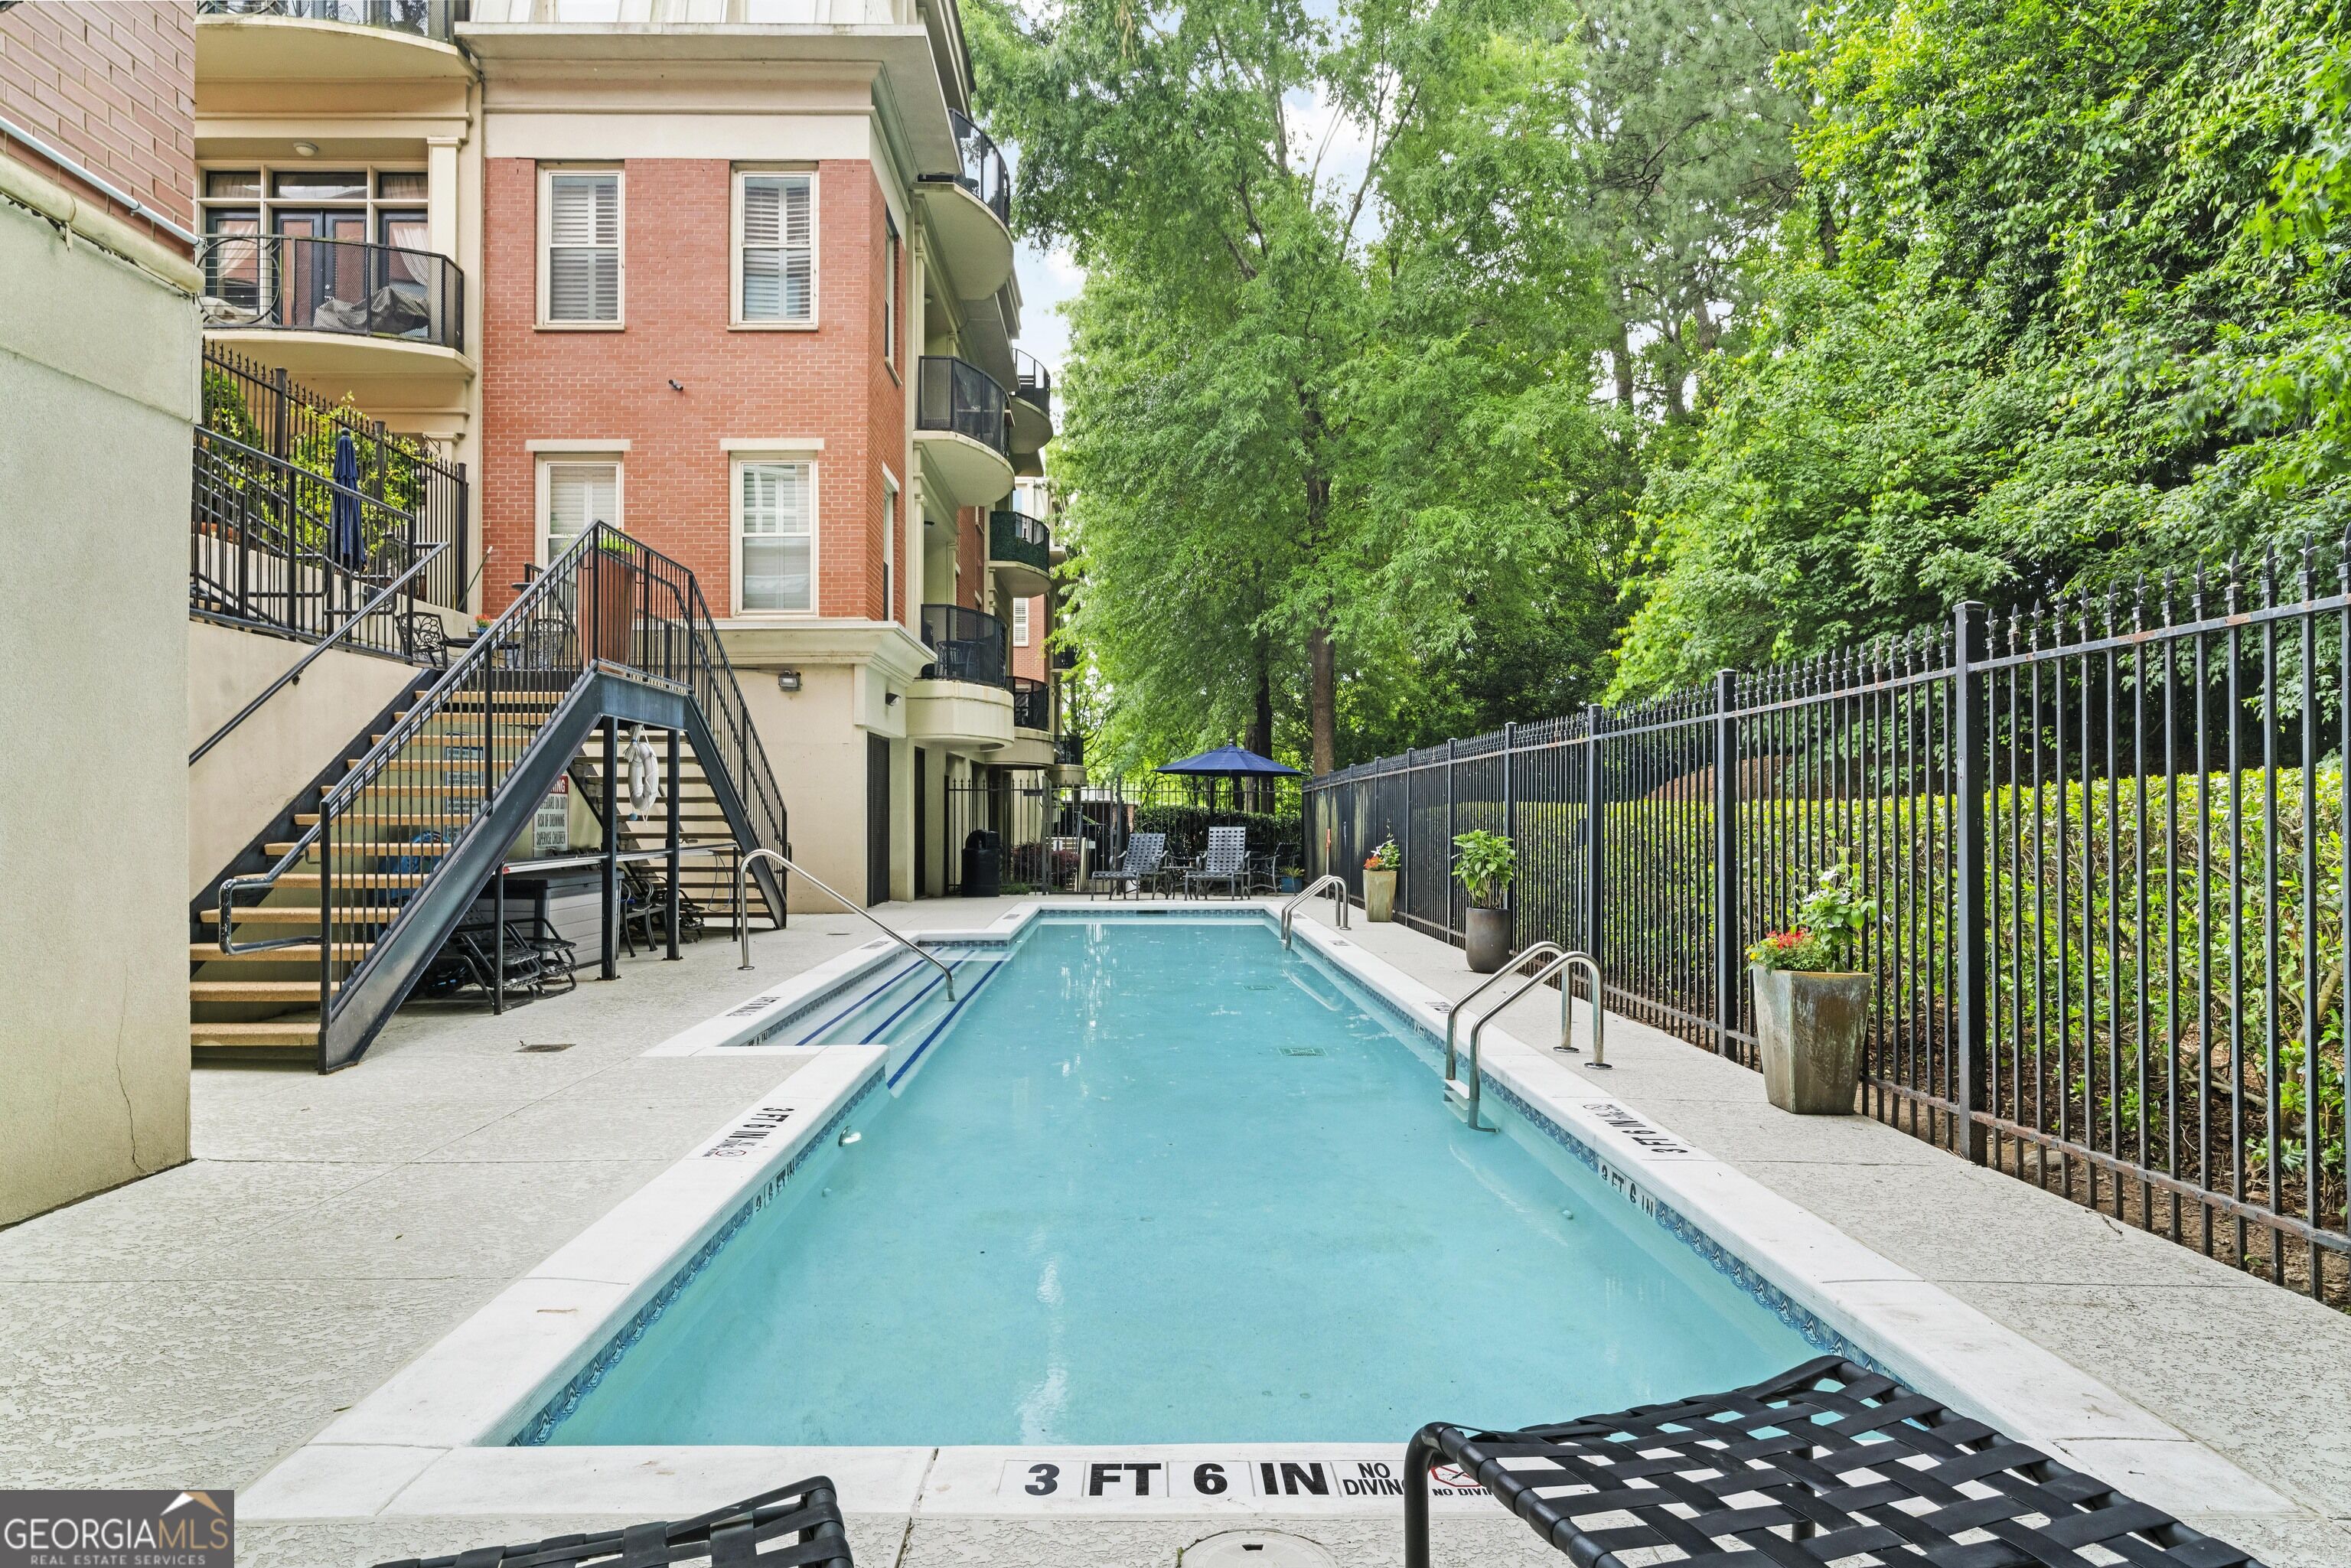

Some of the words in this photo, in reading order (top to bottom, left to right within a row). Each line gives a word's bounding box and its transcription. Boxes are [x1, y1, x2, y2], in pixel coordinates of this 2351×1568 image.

[549, 813, 565, 826] DROWNING
[751, 1113, 789, 1122] FT
[729, 1130, 770, 1139] IN
[1631, 1137, 1678, 1146] FT
[1612, 1172, 1624, 1193] FT
[1629, 1182, 1636, 1204] 6
[1642, 1195, 1653, 1218] IN
[1358, 1462, 1391, 1479] NO
[1025, 1463, 1060, 1496] 3
[1088, 1462, 1161, 1496] FT
[1193, 1463, 1228, 1495] 6
[1260, 1462, 1330, 1495] IN
[1342, 1478, 1405, 1496] DIVIN
